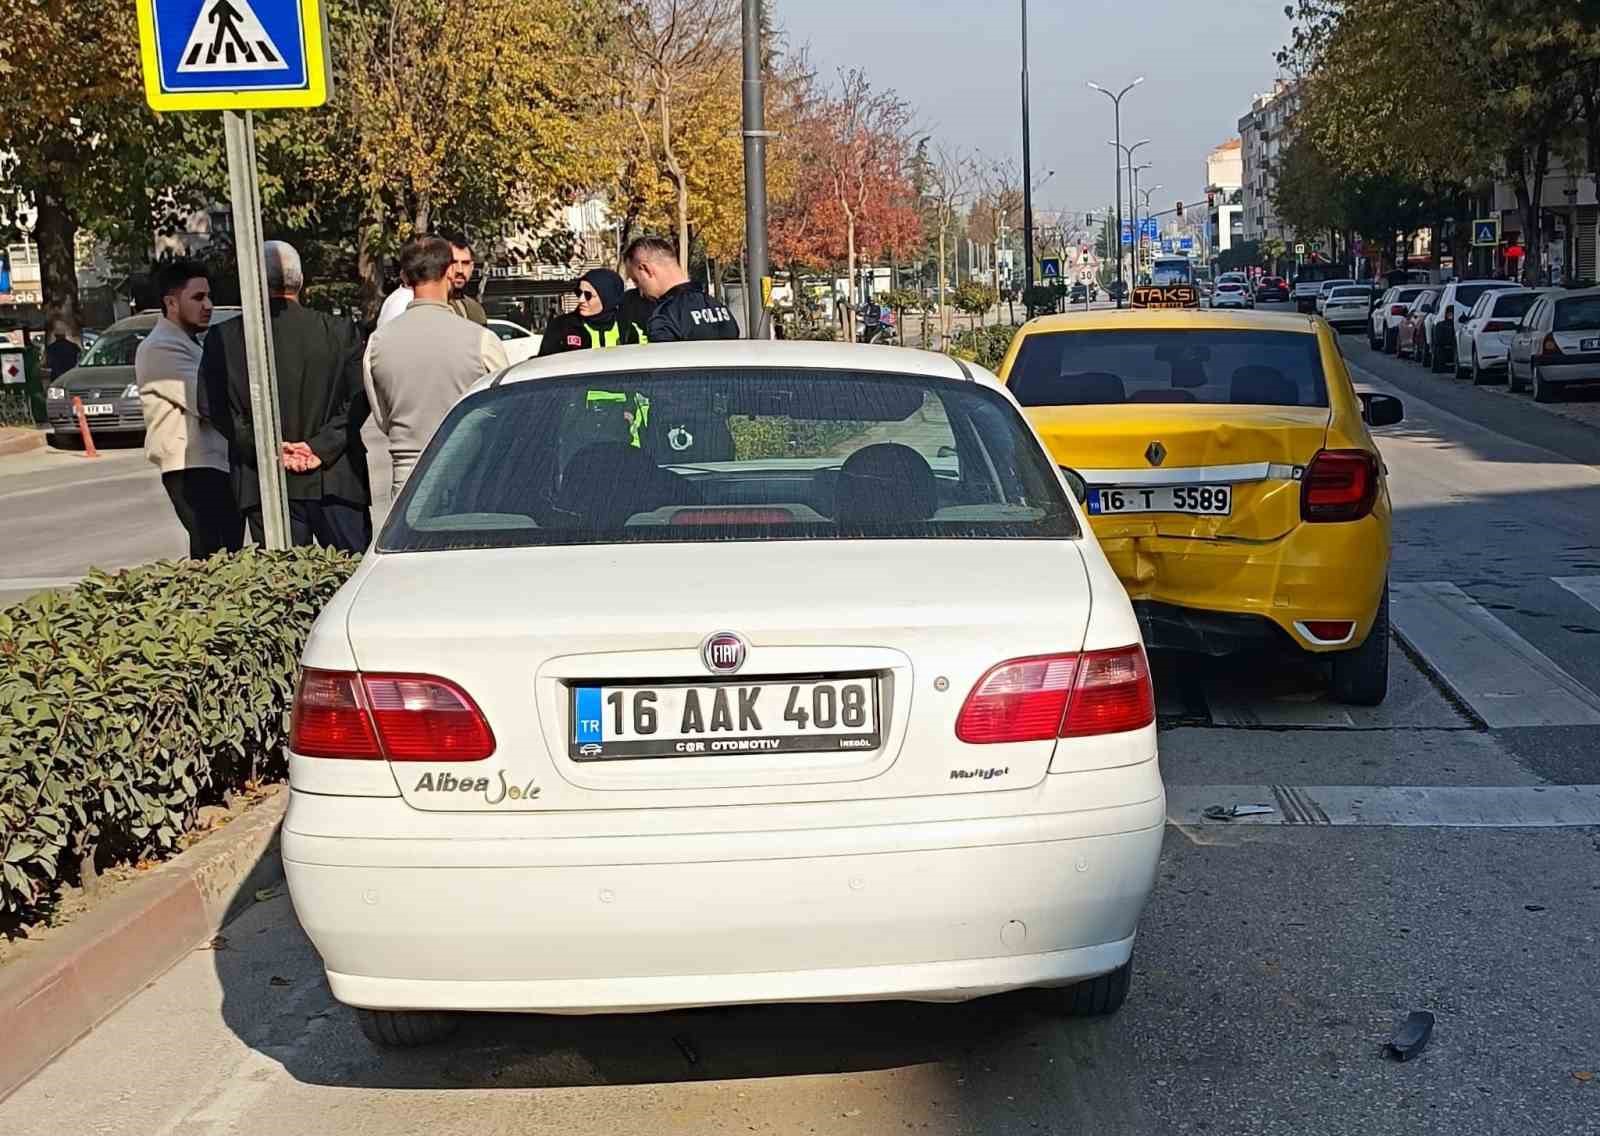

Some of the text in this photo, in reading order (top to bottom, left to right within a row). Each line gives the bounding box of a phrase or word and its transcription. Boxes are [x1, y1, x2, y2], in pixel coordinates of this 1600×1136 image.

[1080, 271, 1092, 281] 30
[1101, 487, 1229, 511] 16 T 5589
[713, 644, 738, 664] FIAT
[606, 684, 866, 736] 16 AAK 408
[580, 719, 600, 733] TR
[414, 768, 541, 805] Albea Sole
